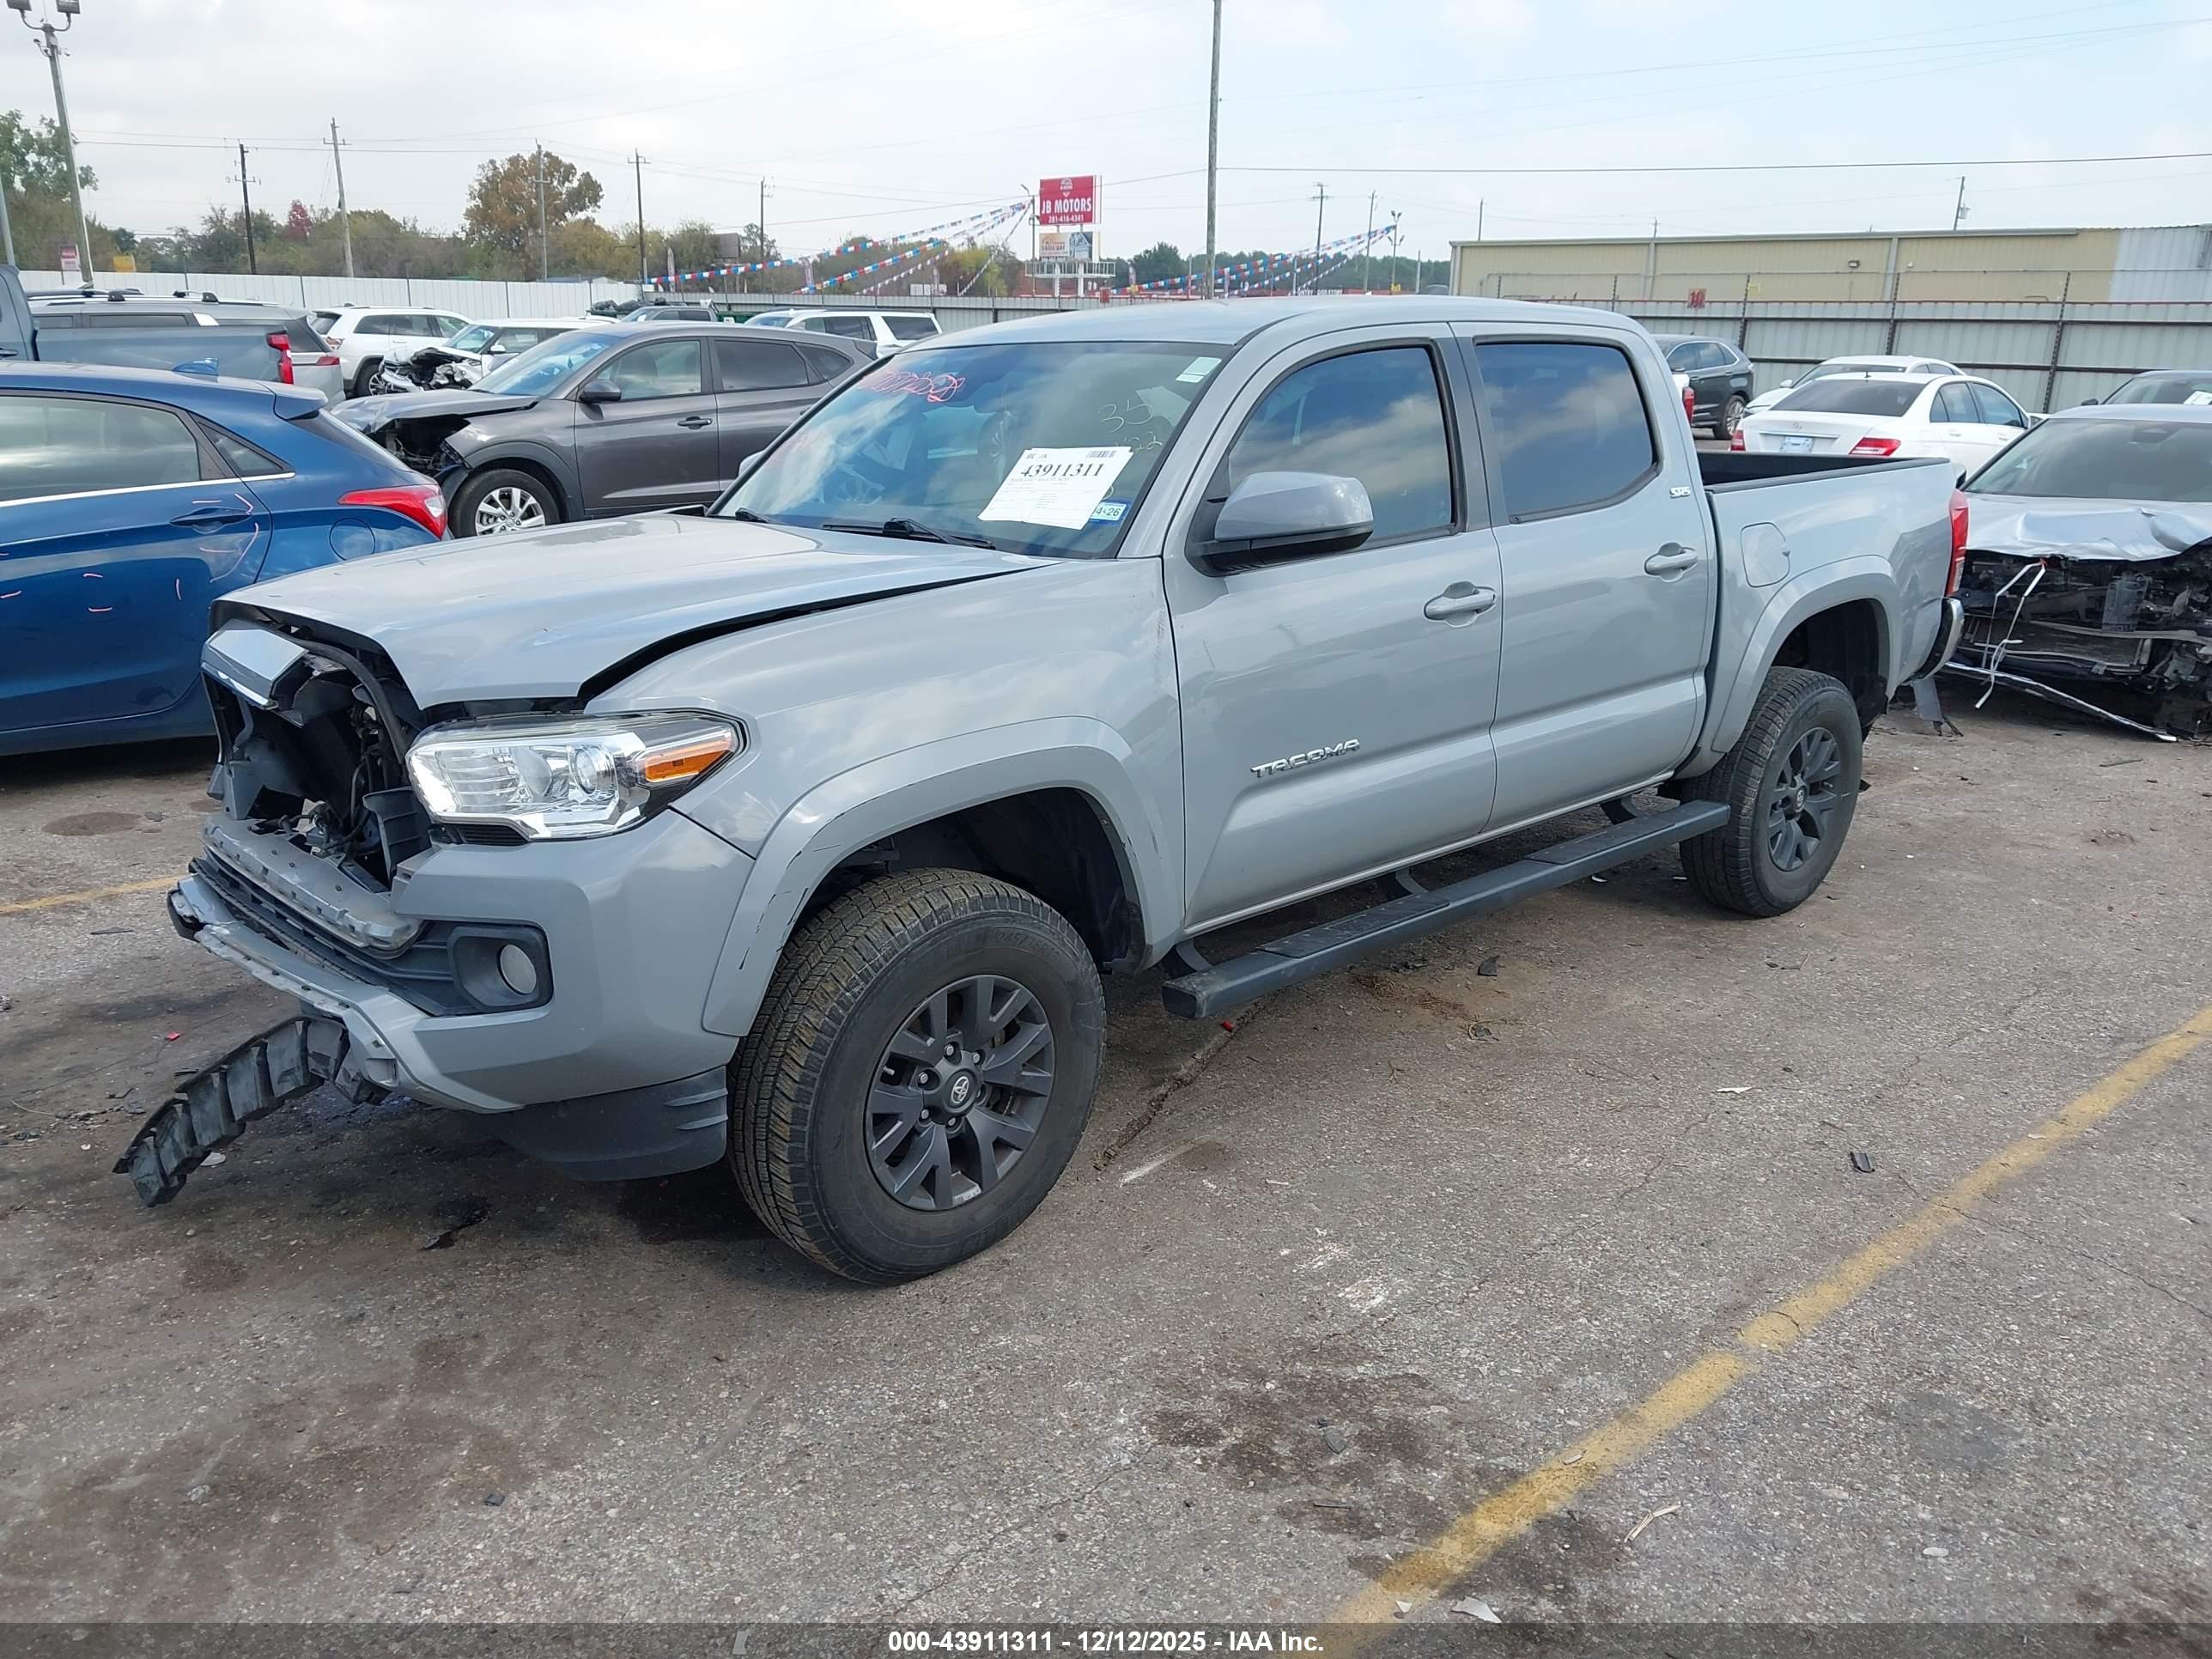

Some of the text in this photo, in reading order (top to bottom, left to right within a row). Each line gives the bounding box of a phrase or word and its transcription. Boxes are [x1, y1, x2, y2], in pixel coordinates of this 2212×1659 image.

[1042, 198, 1091, 214] JB MOTORS
[1098, 398, 1155, 434] 35
[1020, 462, 1105, 477] 43911311
[1668, 486, 1692, 499] SR5
[1250, 738, 1361, 778] TACOMA
